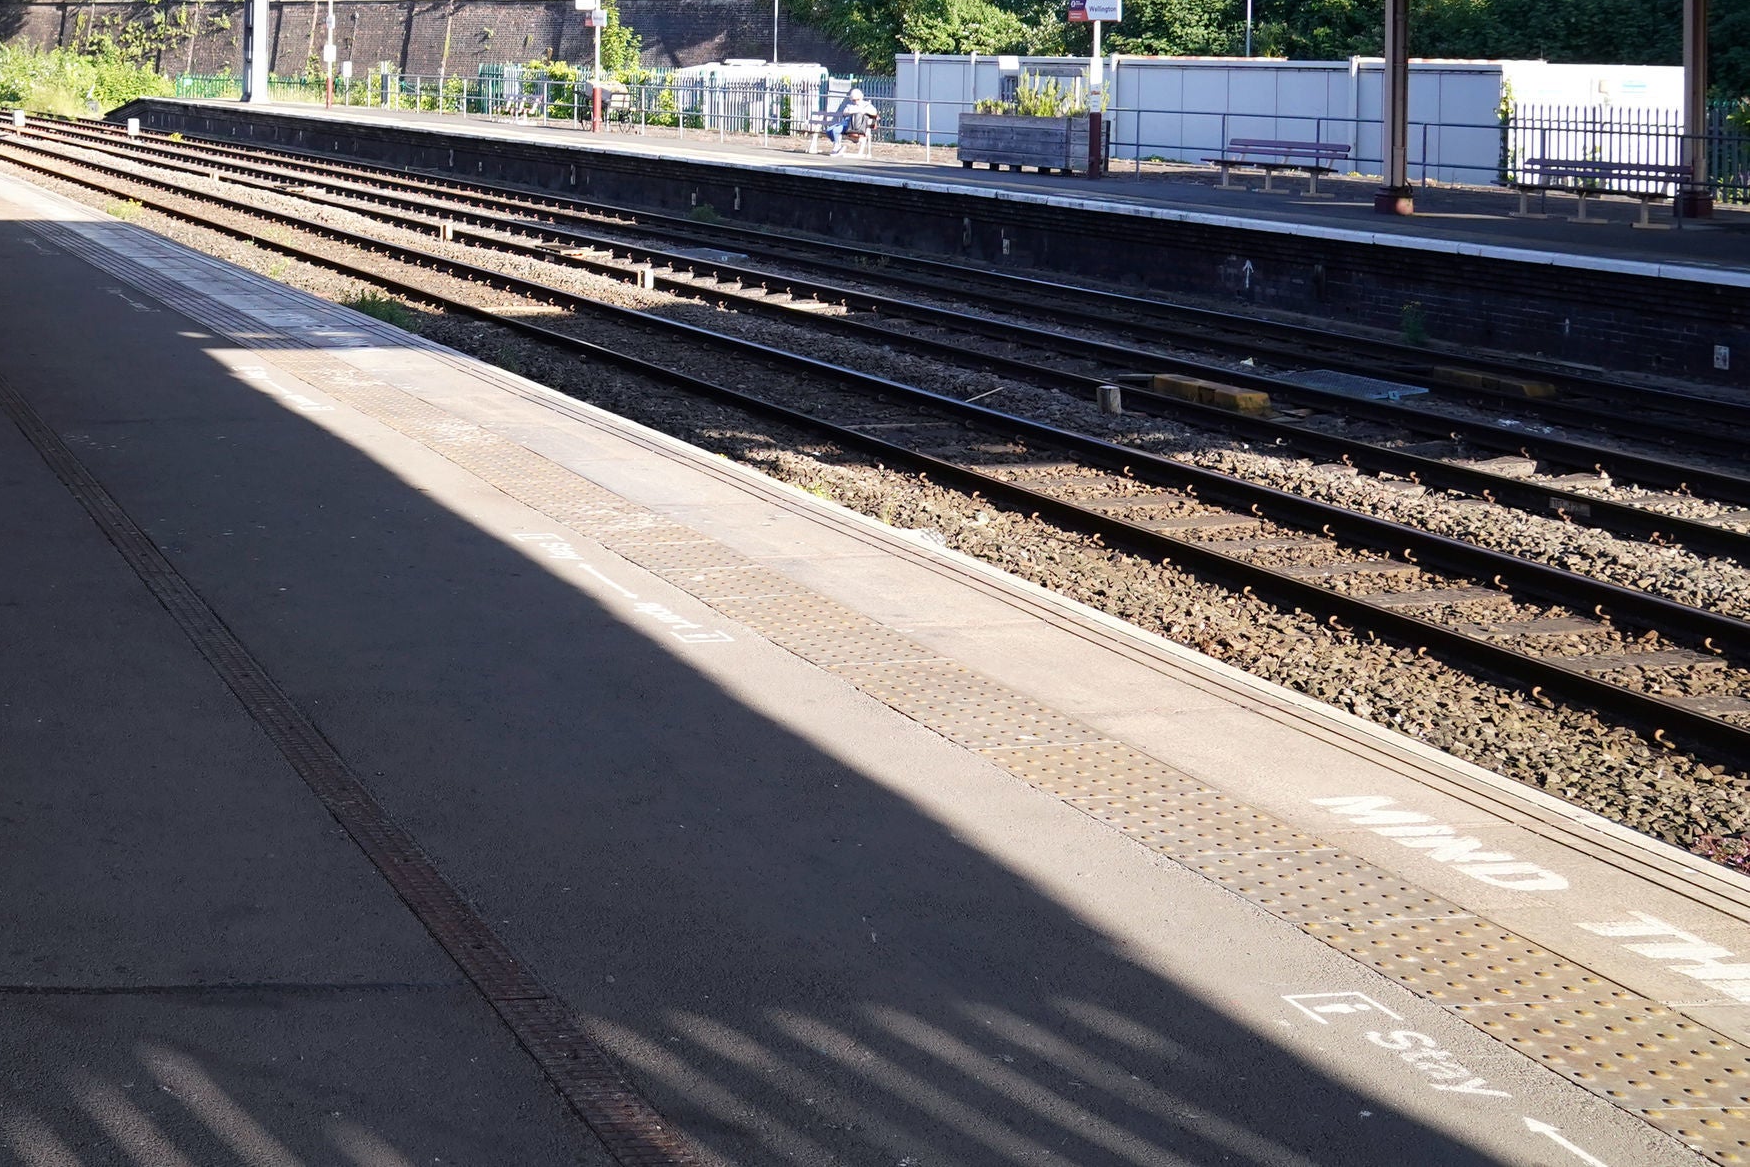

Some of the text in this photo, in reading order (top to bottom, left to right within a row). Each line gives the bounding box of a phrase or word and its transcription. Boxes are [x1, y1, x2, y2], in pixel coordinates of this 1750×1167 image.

[1089, 5, 1117, 14] Wellington
[633, 602, 704, 630] apart
[1309, 795, 1569, 891] MIND
[1573, 910, 1750, 1003] TH
[1364, 1029, 1513, 1098] Stay
